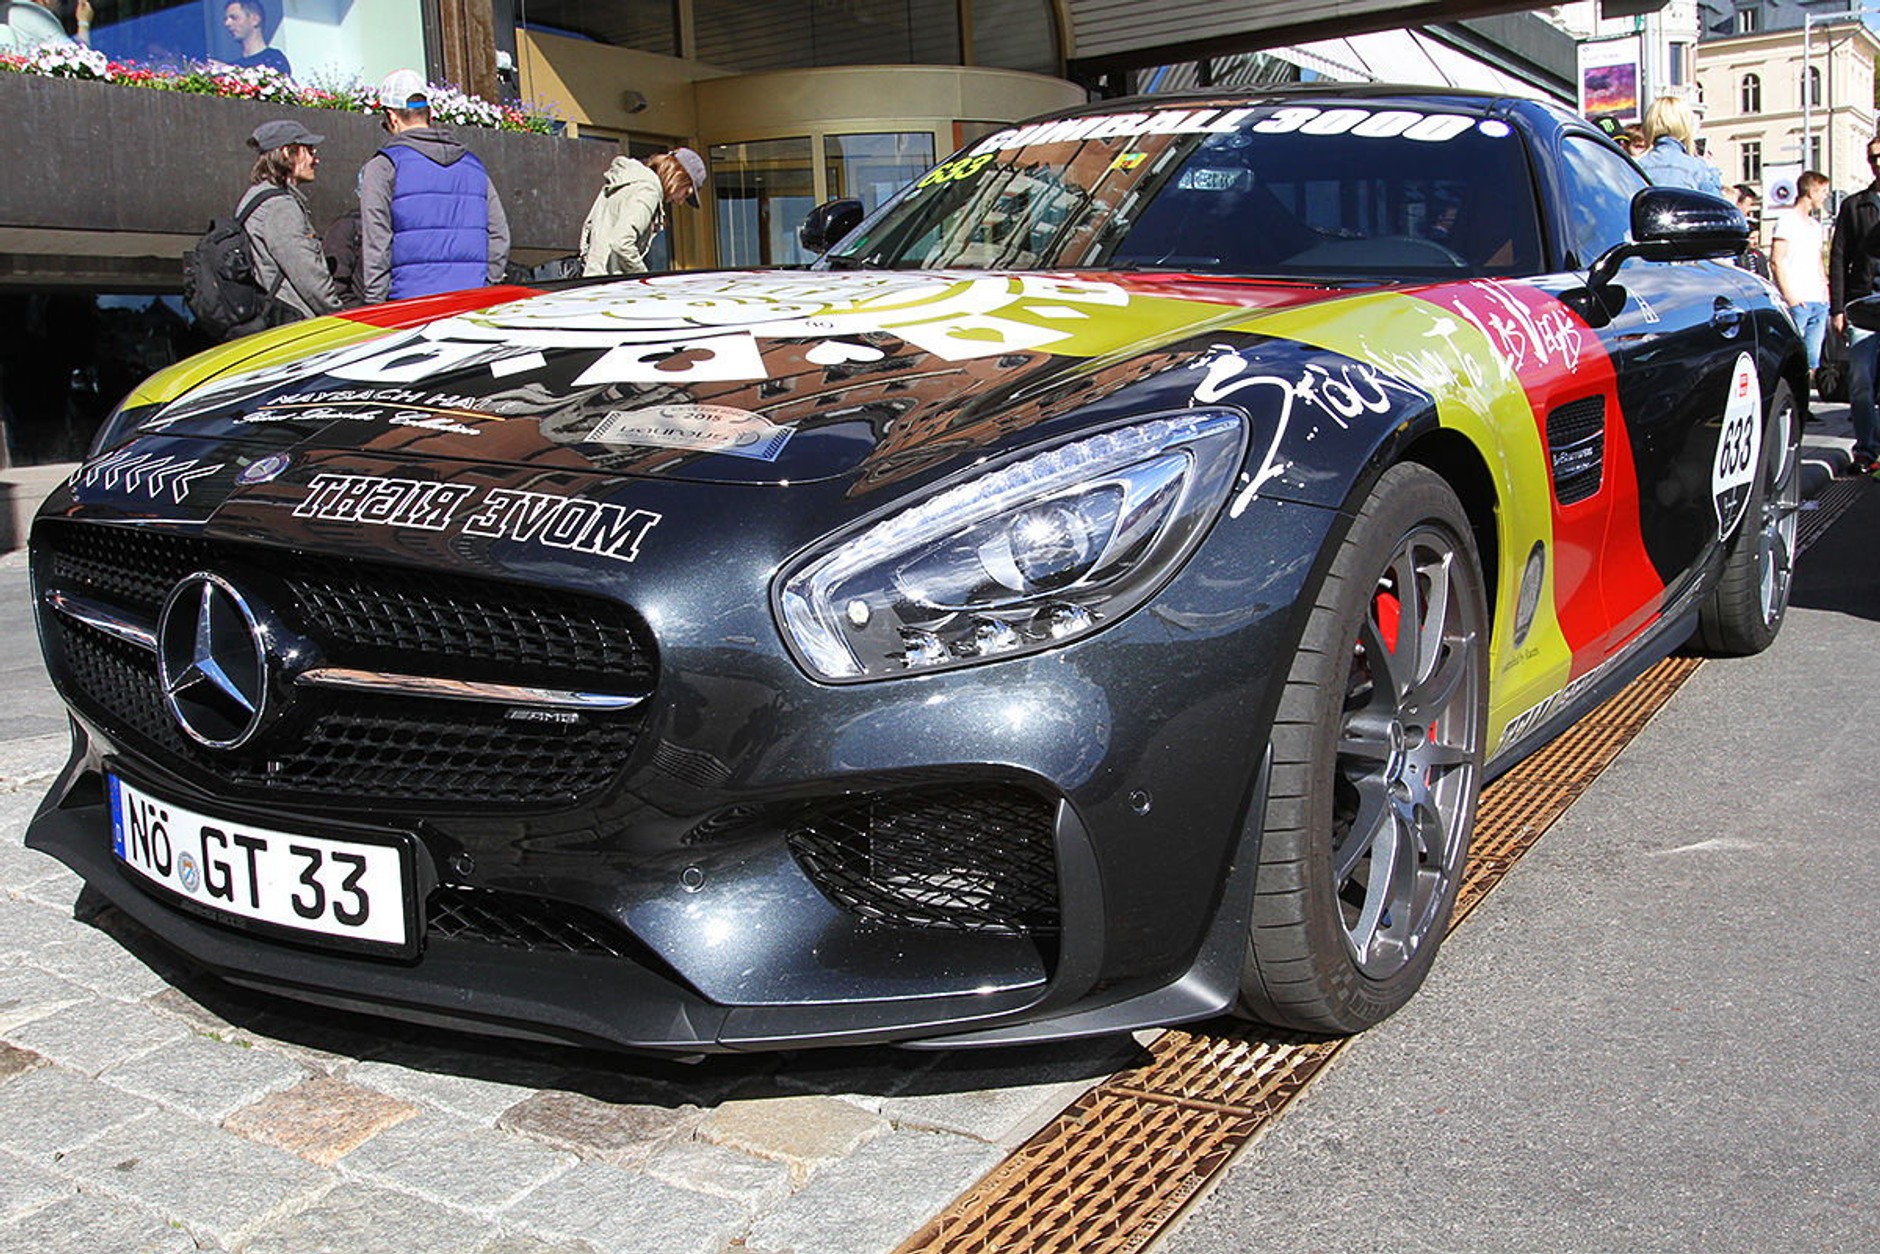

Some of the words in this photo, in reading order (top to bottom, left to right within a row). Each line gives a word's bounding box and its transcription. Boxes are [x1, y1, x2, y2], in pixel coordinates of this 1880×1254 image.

[968, 108, 1254, 157] GUMBALL
[1252, 107, 1476, 142] 3000
[917, 153, 994, 188] 633
[1720, 414, 1753, 479] 633
[128, 793, 173, 877] NÖ
[200, 825, 268, 909] GT
[289, 844, 370, 927] 33
